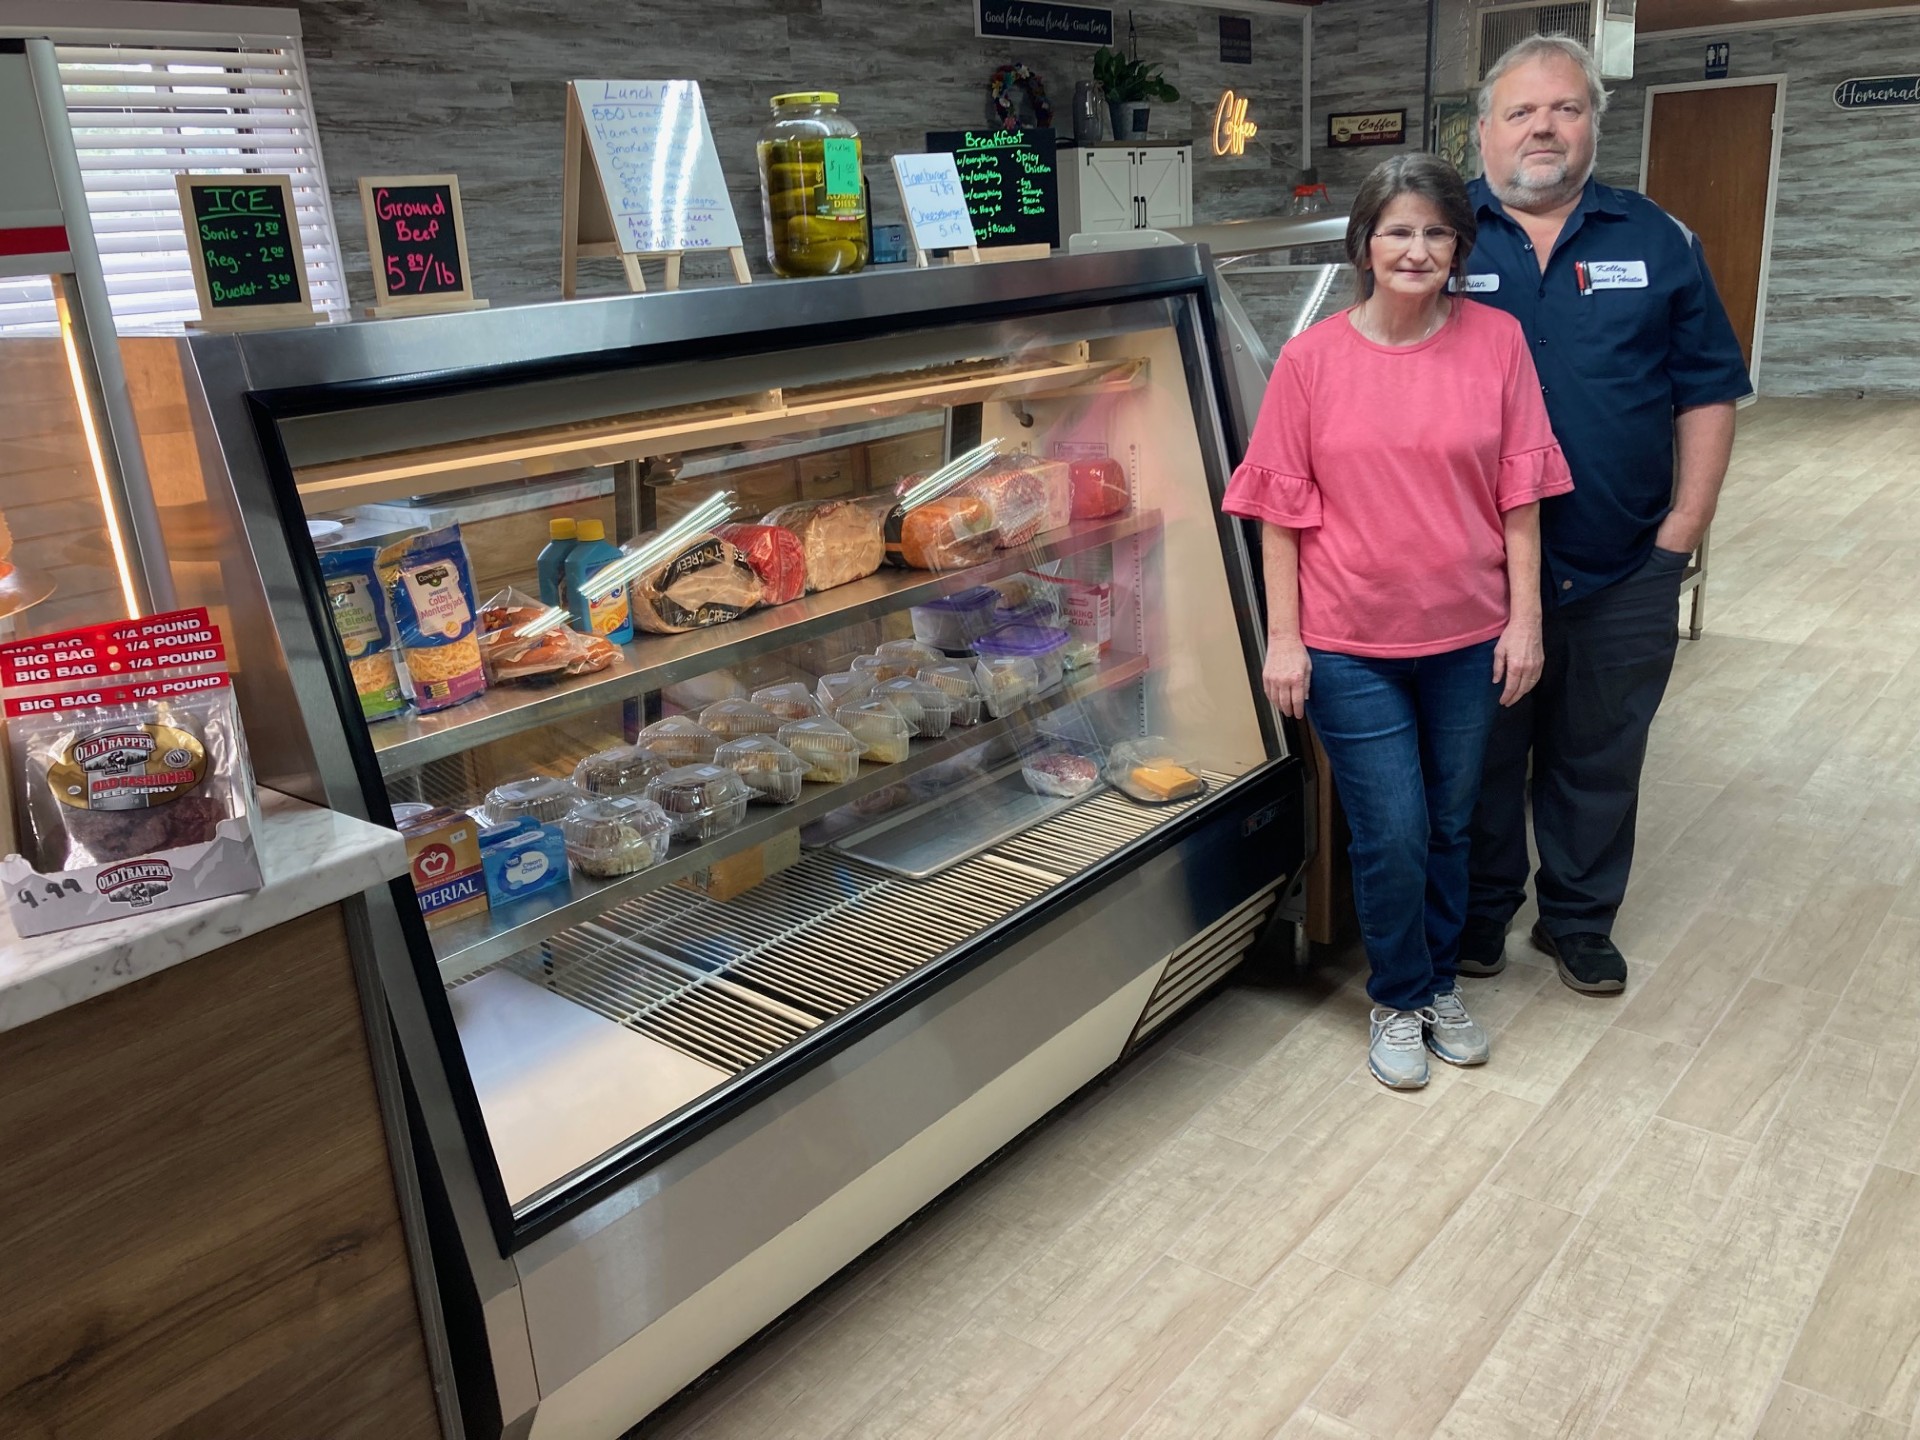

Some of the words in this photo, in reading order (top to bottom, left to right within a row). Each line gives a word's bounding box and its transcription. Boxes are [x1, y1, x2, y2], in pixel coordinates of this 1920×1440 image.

[985, 10, 1004, 23] Good
[1026, 15, 1044, 26] Good
[1072, 20, 1089, 31] Good
[604, 82, 652, 100] Lunch
[1214, 90, 1257, 156] Coffee
[1358, 118, 1398, 131] Coffee
[596, 126, 630, 140] Ham
[965, 130, 1024, 148] Breakfast
[607, 142, 650, 156] Smoked
[1016, 150, 1039, 166] Spicy
[1025, 163, 1051, 174] Chicken
[1020, 178, 1032, 188] Egg
[203, 188, 274, 212] ICE
[376, 188, 445, 220] Ground
[686, 212, 714, 223] heese
[200, 224, 239, 241] Sonic
[396, 219, 439, 241] Beef
[681, 237, 713, 247] Cheese
[206, 250, 241, 274] Reg.
[1595, 265, 1627, 274] Kelley
[420, 600, 452, 620] Monterey
[451, 596, 465, 609] Jack
[428, 593, 449, 607] Colby
[345, 613, 374, 627] Blend
[1063, 608, 1093, 619] BAKING
[112, 628, 138, 640] 1/4
[142, 618, 201, 636] POUND
[1068, 618, 1091, 627] ODA
[14, 653, 49, 667] BIG
[54, 648, 95, 662] BAG
[125, 640, 150, 652] 1/4
[154, 630, 212, 648] POUND
[16, 669, 51, 683] BIG
[56, 664, 98, 678] BAG
[128, 658, 153, 669] 1/4
[158, 649, 217, 666] POUND
[19, 698, 55, 712] BIG
[60, 692, 102, 706] BAG
[132, 686, 158, 698] 1/4
[162, 676, 221, 693] POUND
[76, 743, 99, 762] OLD
[99, 736, 157, 752] TRAPPER
[91, 777, 119, 791] OLD
[121, 770, 195, 787] FASHIONED
[92, 788, 130, 800] BEEF
[131, 785, 178, 795] JERKY
[521, 862, 543, 875] Cheese
[522, 858, 543, 869] Cream
[98, 871, 118, 890] OLD
[117, 864, 171, 881] TRAPPER
